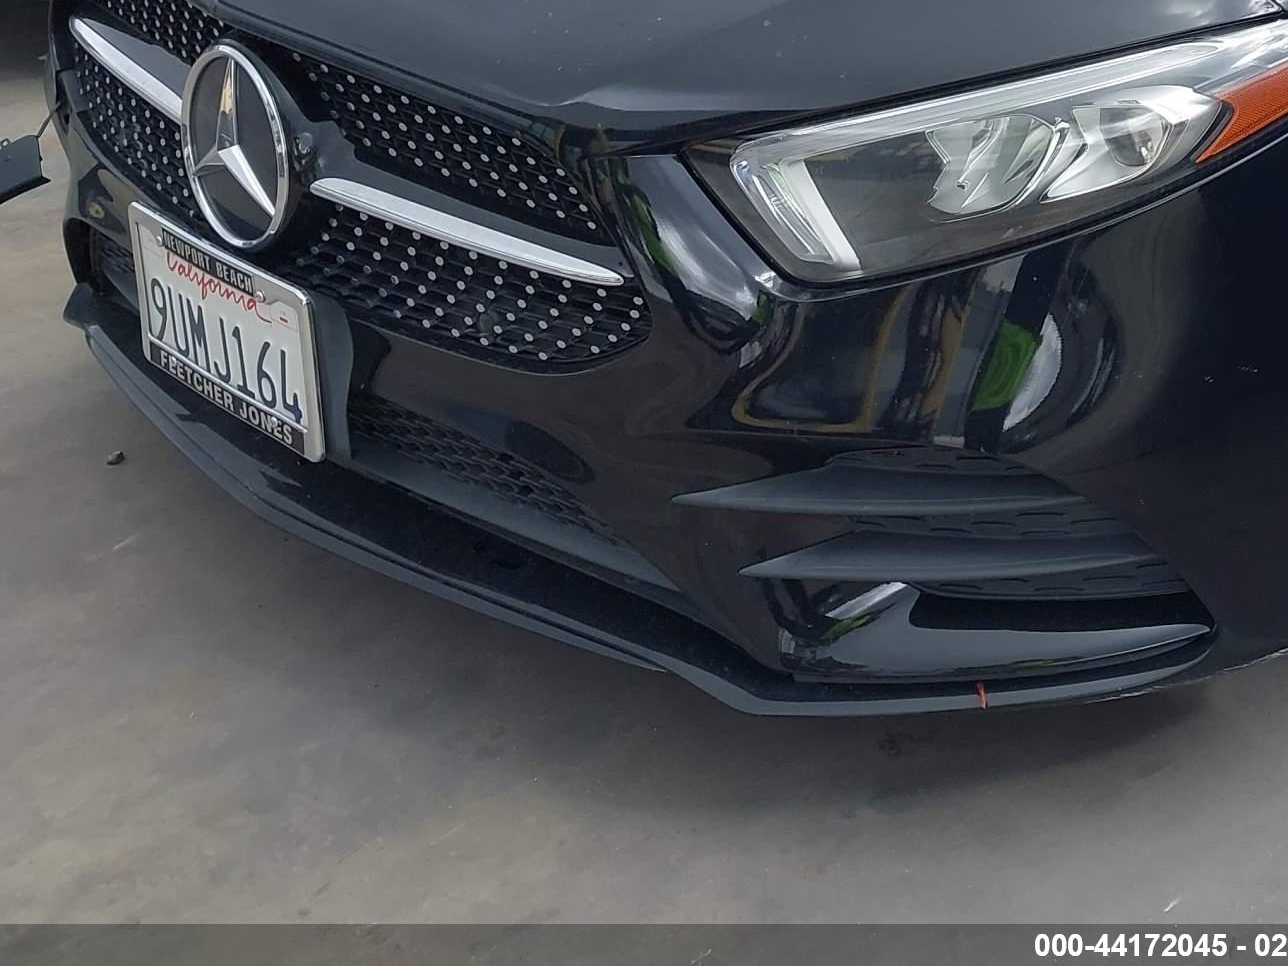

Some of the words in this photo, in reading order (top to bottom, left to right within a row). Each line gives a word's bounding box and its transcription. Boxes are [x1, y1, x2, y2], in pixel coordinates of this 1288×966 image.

[163, 230, 211, 273] NEWPORT
[216, 262, 254, 294] BEACH
[166, 251, 273, 324] California
[150, 277, 303, 425] 9UMJ164
[160, 349, 235, 413] FLETCHER
[239, 401, 294, 446] JONES
